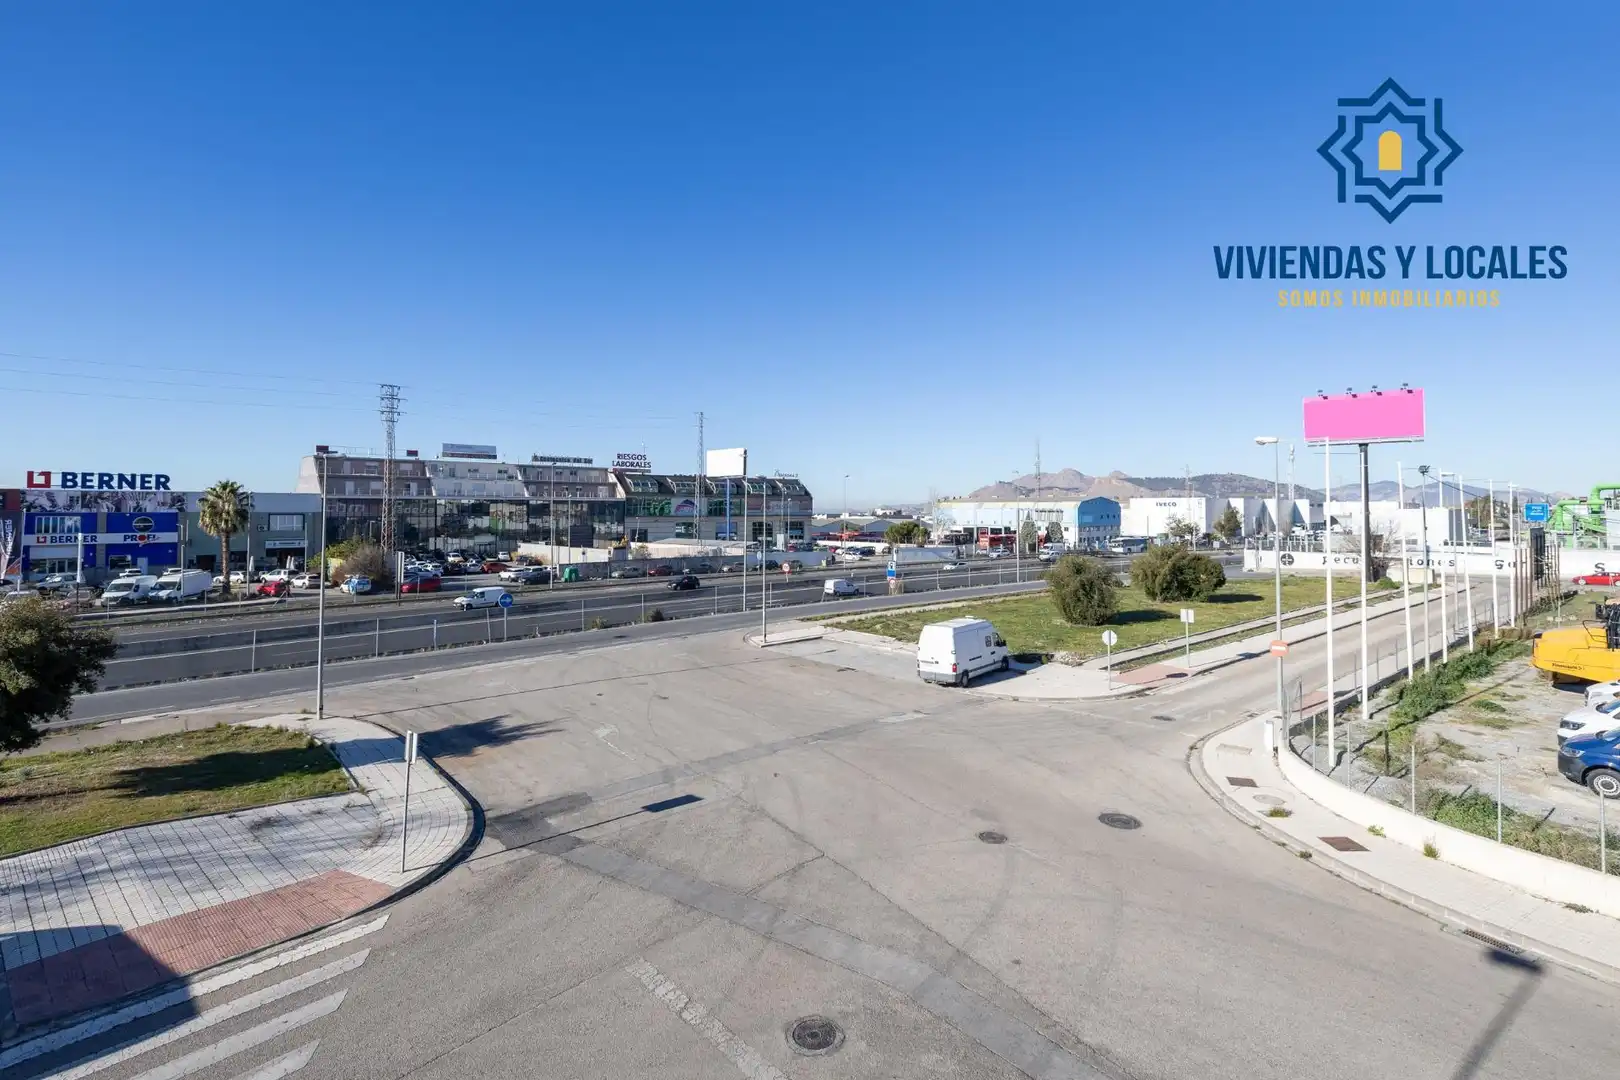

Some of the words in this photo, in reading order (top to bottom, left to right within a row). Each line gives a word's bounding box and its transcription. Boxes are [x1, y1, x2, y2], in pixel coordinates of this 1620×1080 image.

[616, 453, 647, 461] RIESGOS
[612, 460, 652, 469] LABORALES
[61, 471, 171, 490] BERNER
[50, 535, 98, 544] BERNER
